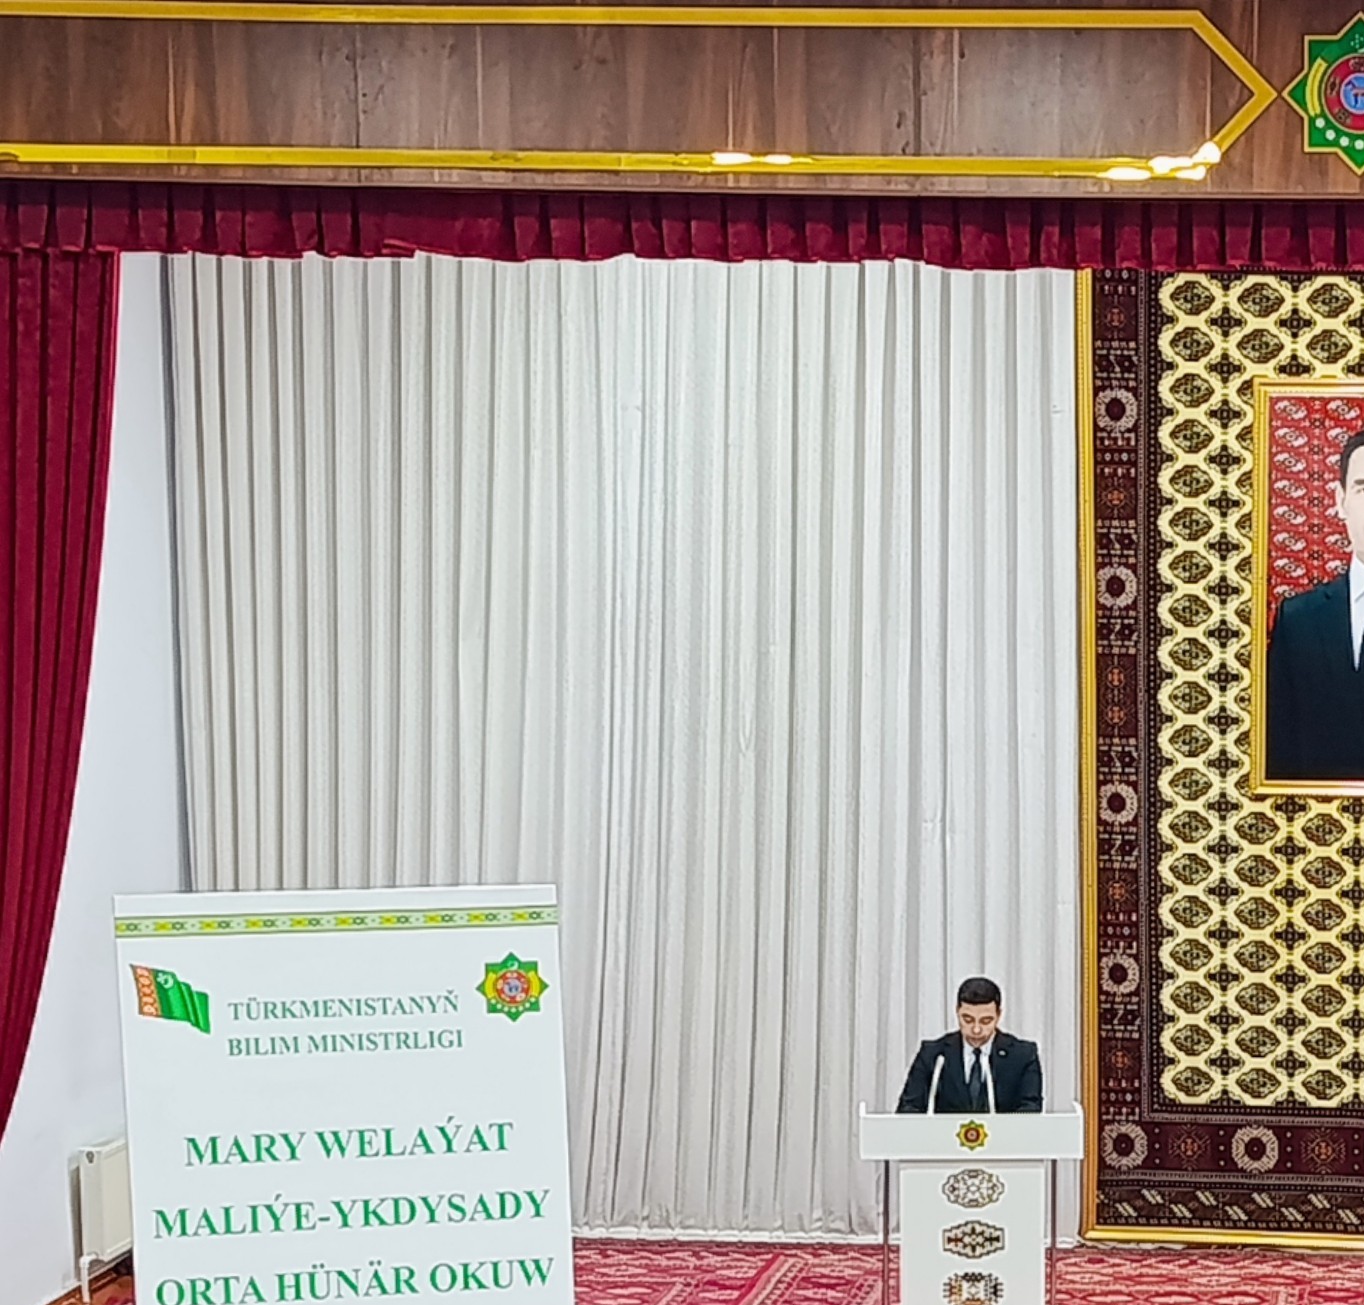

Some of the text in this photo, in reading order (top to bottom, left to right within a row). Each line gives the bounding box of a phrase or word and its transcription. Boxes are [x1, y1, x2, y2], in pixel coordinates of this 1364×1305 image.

[228, 989, 459, 1020] TÜRKMENISTANYŇ
[228, 1029, 463, 1057] BILIM MINISTRLIGI
[184, 1116, 514, 1167] MARY WELAÝAT
[152, 1189, 550, 1239] MALIÝE-YKDYSADY
[275, 1260, 420, 1303] HÜNÄR
[429, 1257, 554, 1293] OKUW
